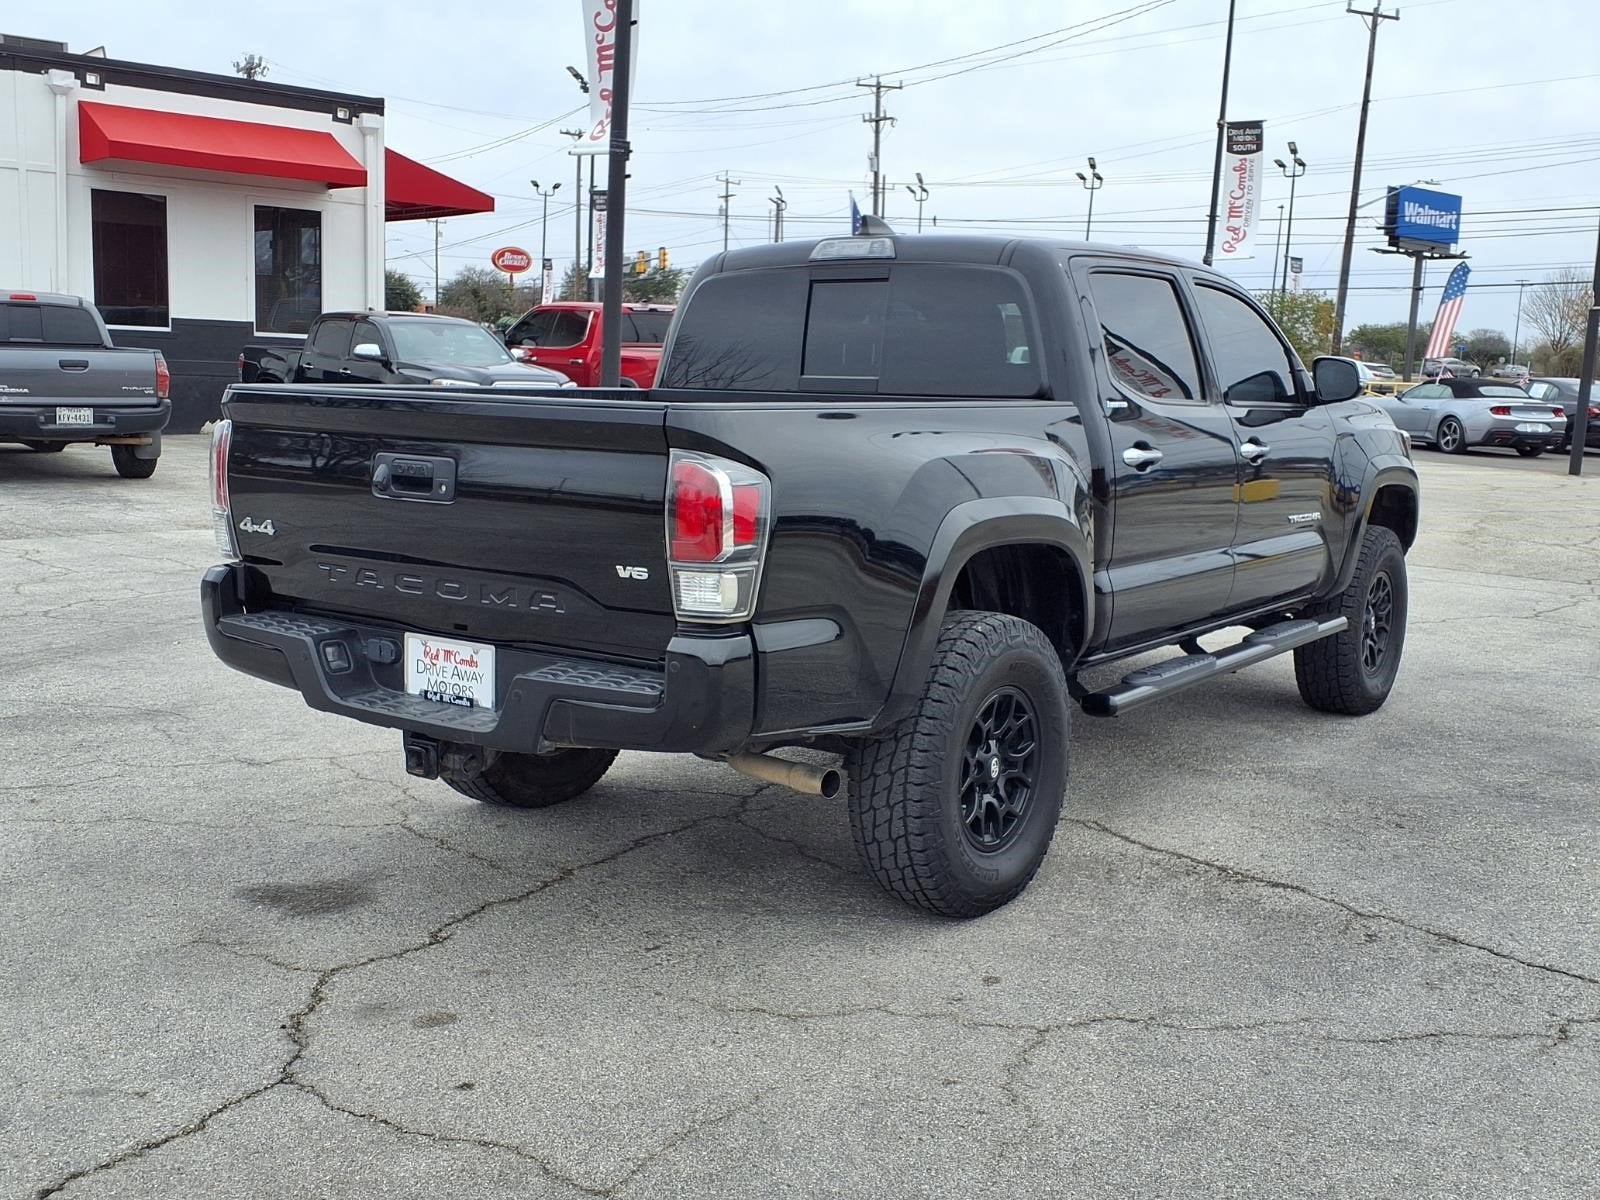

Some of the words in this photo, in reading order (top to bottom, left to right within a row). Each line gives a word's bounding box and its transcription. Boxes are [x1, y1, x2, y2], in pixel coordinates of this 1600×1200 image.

[1227, 158, 1248, 223] McCombs
[1247, 185, 1253, 196] TO
[1243, 199, 1254, 228] DRIVEN
[1404, 201, 1457, 230] Walmart
[1222, 225, 1247, 253] Red
[239, 516, 276, 536] 4x4
[615, 565, 649, 580] V6
[318, 563, 565, 613] TACOMA
[423, 645, 440, 666] Red
[440, 647, 478, 669] McCombs
[416, 659, 448, 678] DRIVE
[451, 665, 485, 685] AWAY
[426, 676, 474, 698] MOTORS
[427, 690, 440, 702] Red
